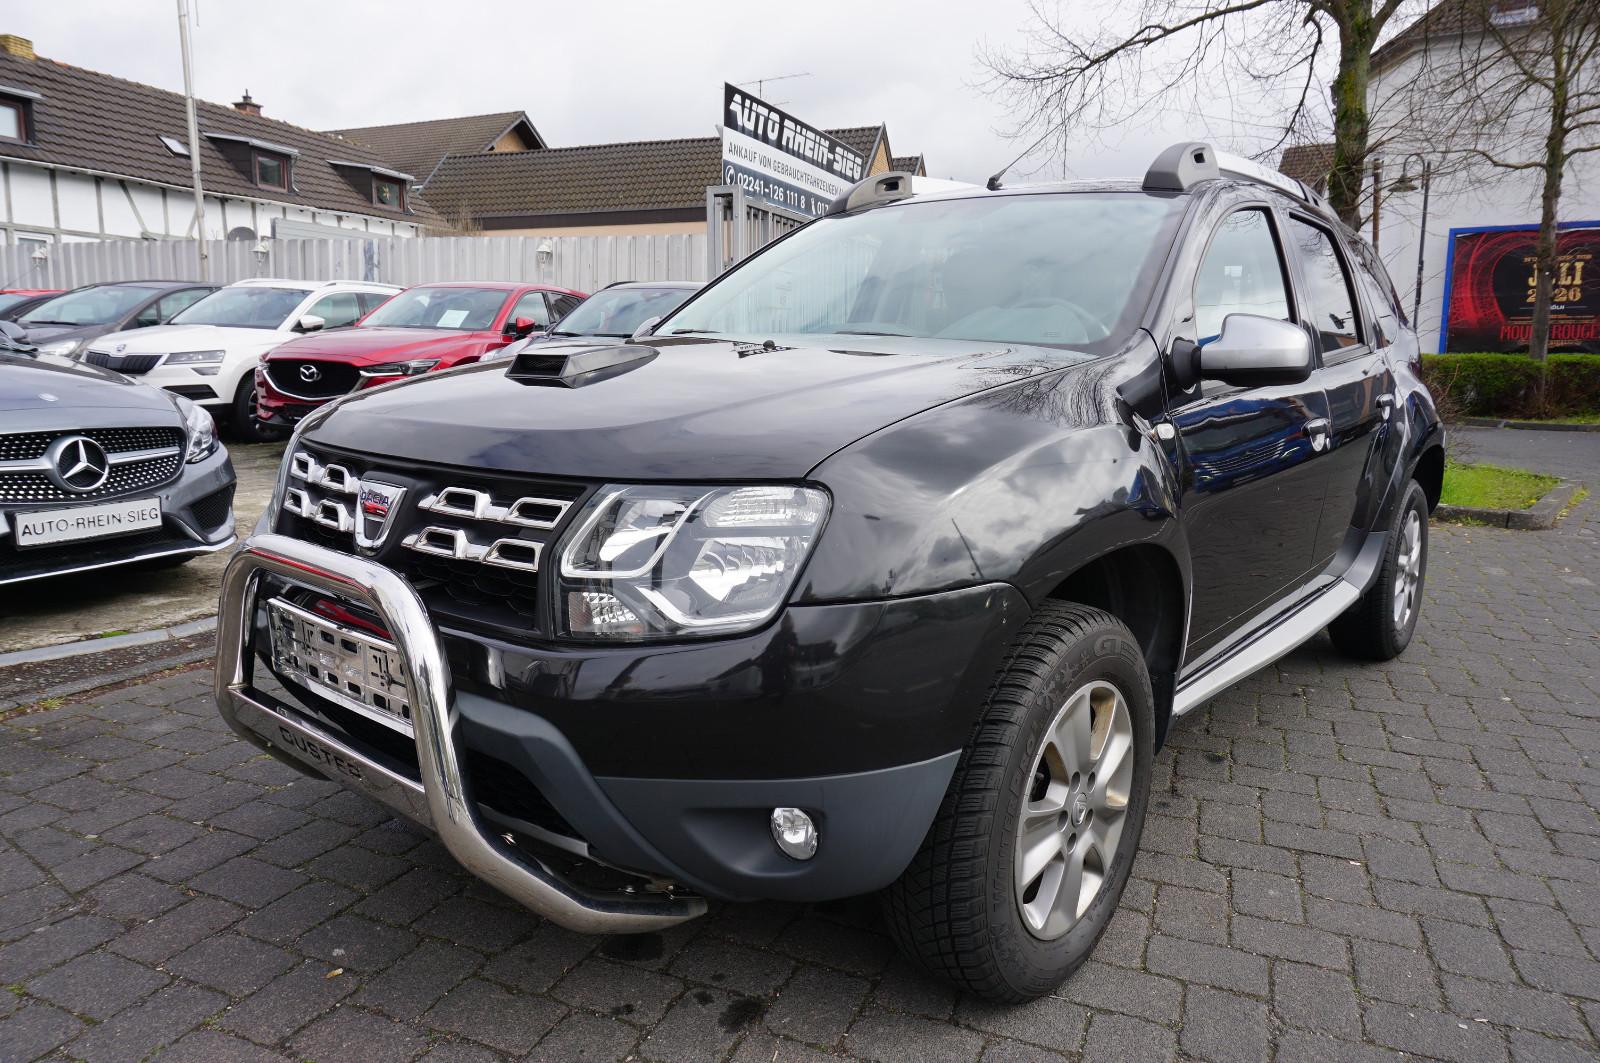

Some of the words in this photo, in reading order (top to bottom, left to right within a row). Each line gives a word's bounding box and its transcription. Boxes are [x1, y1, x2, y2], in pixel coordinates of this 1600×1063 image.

[729, 93, 780, 141] AUTO
[728, 141, 758, 164] ANKAUF
[758, 152, 772, 169] VON
[772, 159, 839, 197] GEBRAUCHTFAHRZEUGEN
[737, 172, 784, 202] 02241-126
[786, 190, 798, 206] 111
[800, 195, 806, 209] 8
[1526, 287, 1582, 303] 226
[279, 725, 361, 778] DUSTER
